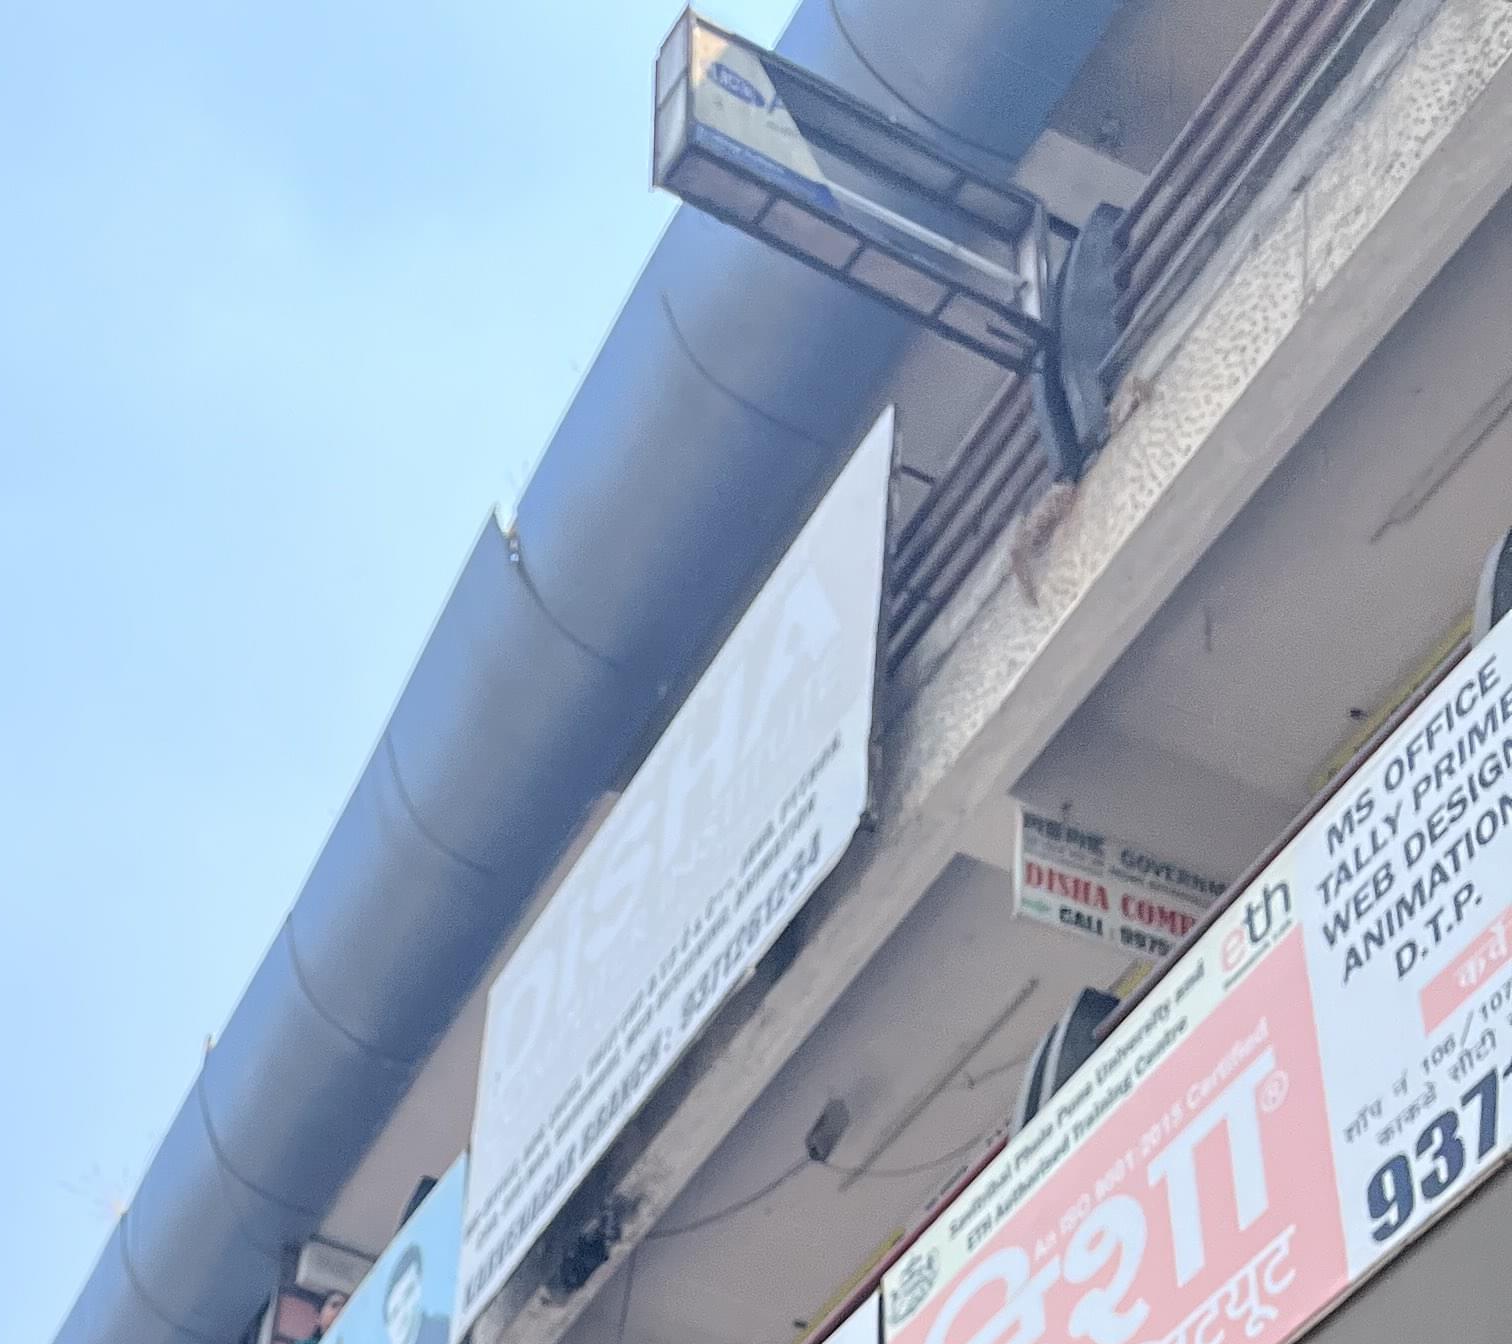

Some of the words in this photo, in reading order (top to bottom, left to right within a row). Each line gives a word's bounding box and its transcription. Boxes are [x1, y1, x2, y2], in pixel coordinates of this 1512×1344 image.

[1324, 788, 1376, 857] MS
[1383, 654, 1501, 792] OFFICE
[1024, 860, 1109, 912] DISHA
[1315, 800, 1405, 907] TALLY
[1321, 861, 1396, 948] WEB
[1394, 880, 1485, 981] D.T.P.
